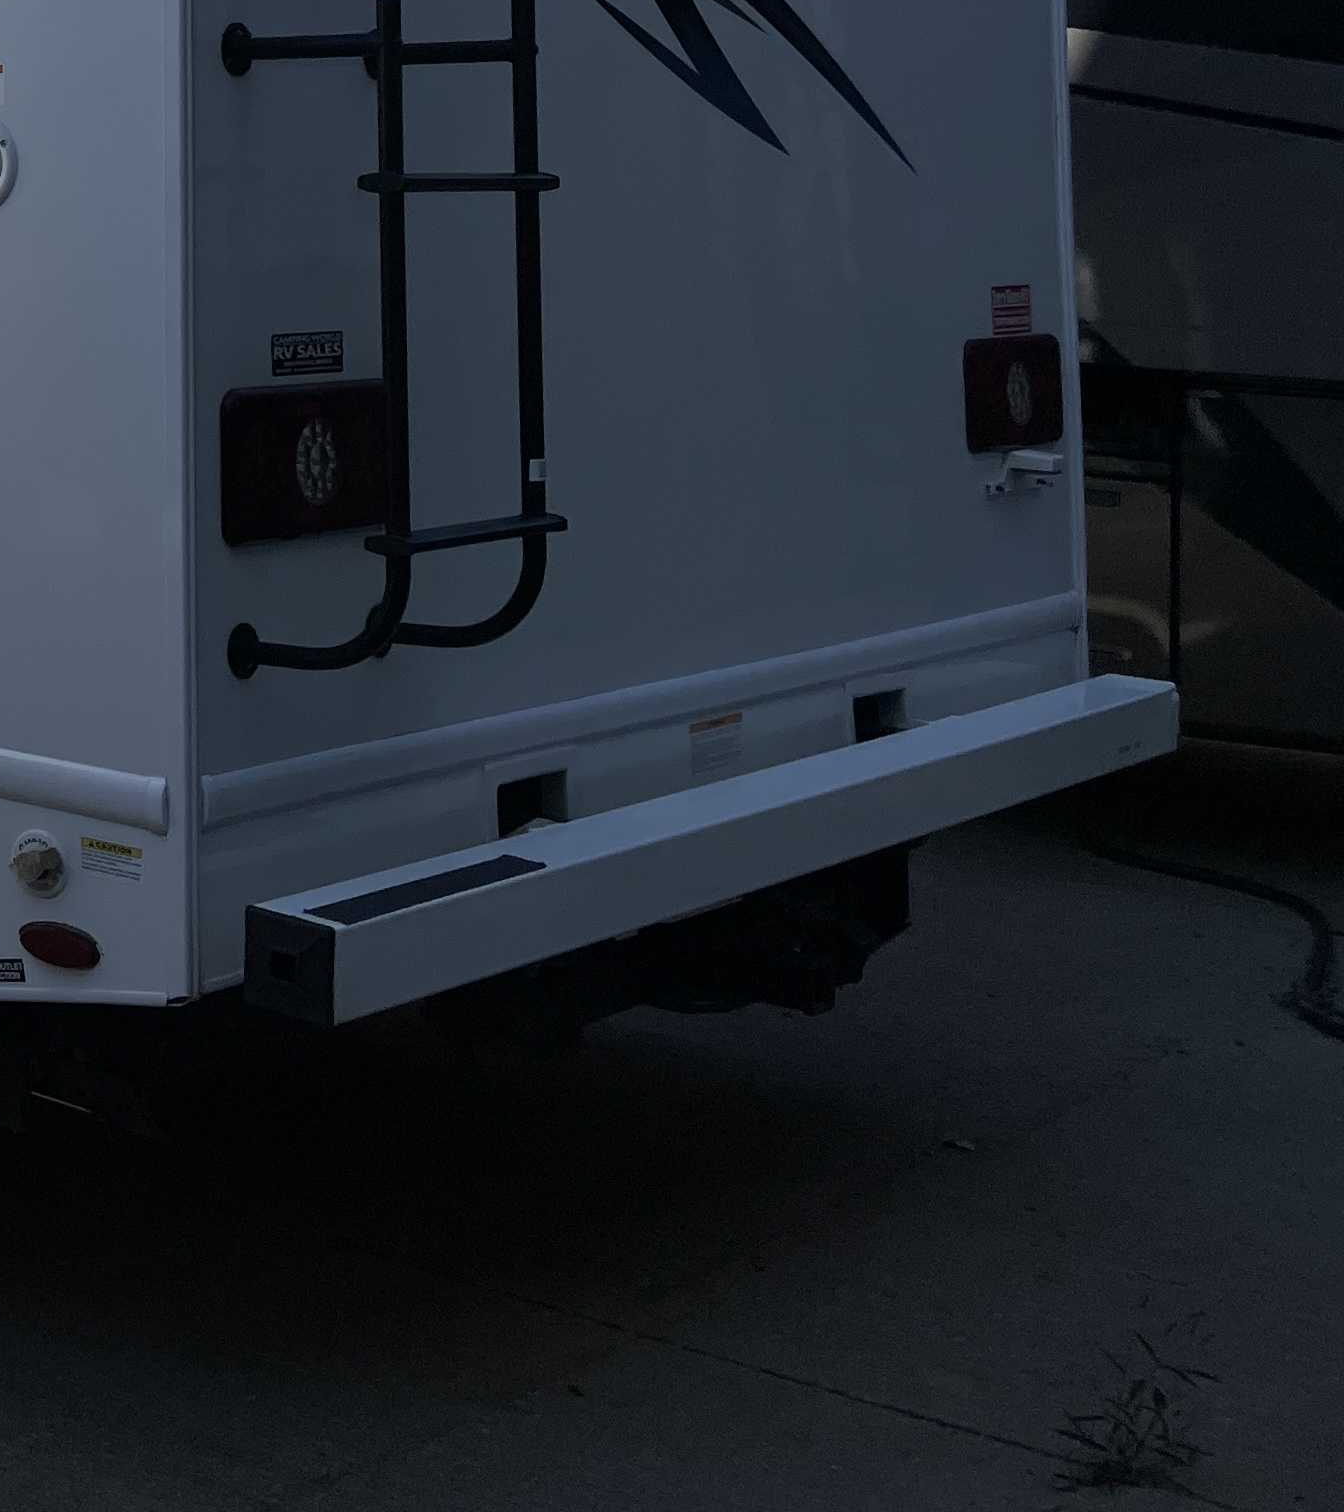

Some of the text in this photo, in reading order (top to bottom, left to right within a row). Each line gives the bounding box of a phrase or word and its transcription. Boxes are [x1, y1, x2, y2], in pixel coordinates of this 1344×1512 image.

[273, 342, 342, 360] RV SALES
[95, 840, 132, 855] CAUTION
